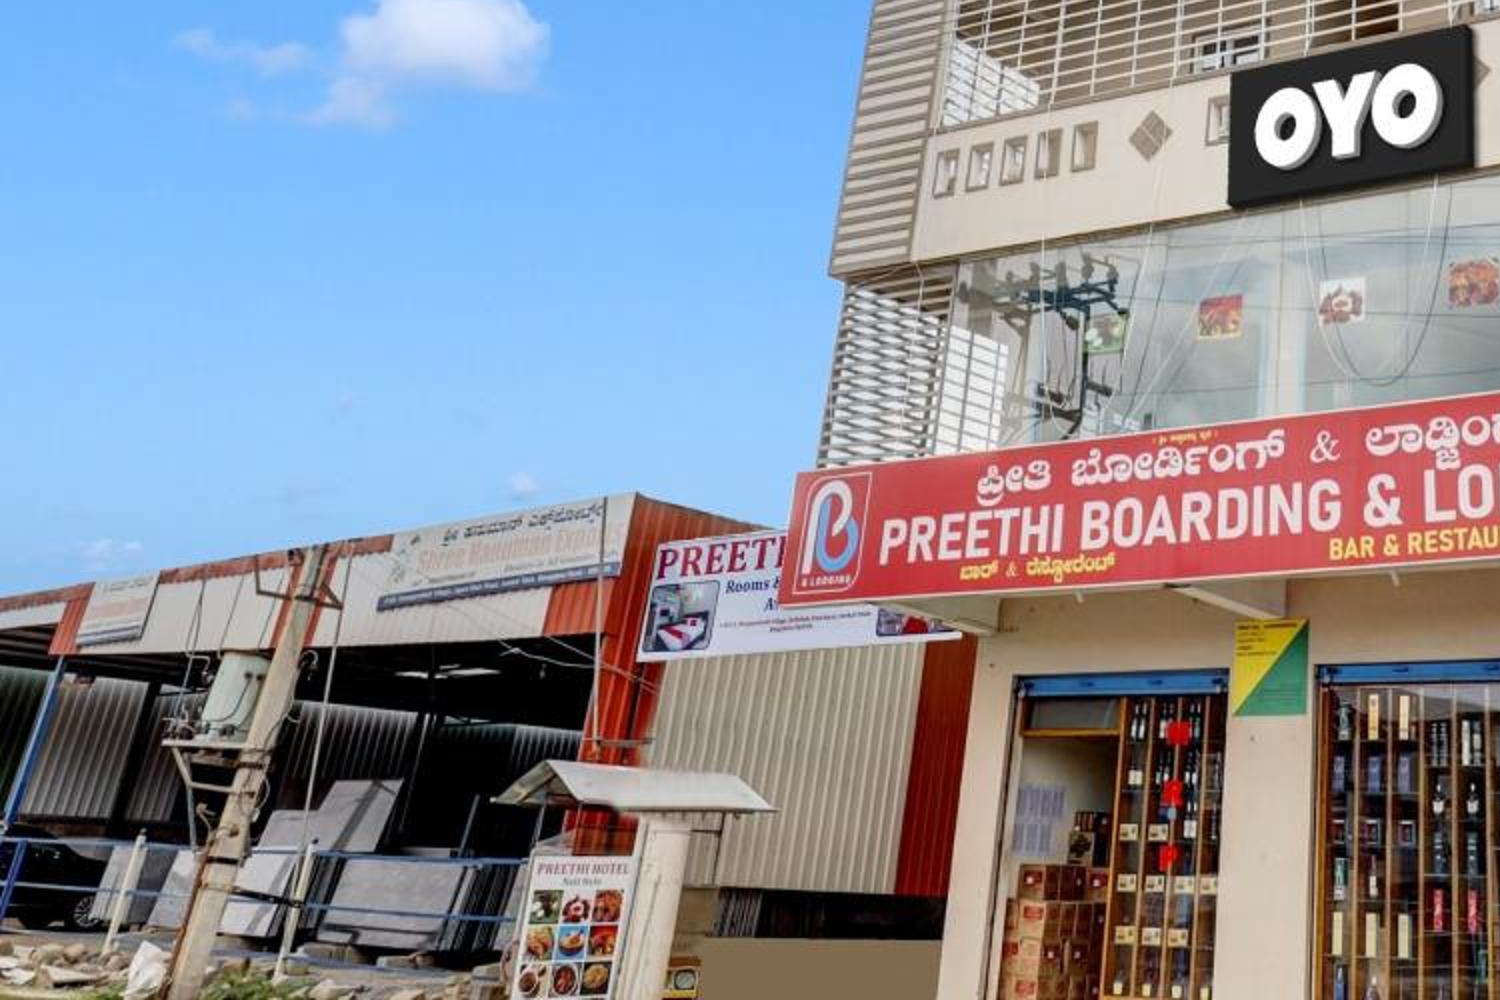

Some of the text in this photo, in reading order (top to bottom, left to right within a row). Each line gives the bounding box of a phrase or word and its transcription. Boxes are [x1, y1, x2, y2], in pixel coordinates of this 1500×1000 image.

[1254, 62, 1444, 171] OYO
[1309, 429, 1341, 464] &
[878, 503, 1064, 566] PREETHI
[1080, 478, 1342, 552] BOARDING
[1363, 473, 1404, 529] &
[1328, 535, 1375, 561] BAR
[1382, 532, 1400, 557] &
[1005, 559, 1019, 578] &
[725, 578, 770, 594] Rooms
[537, 862, 629, 876] PREETHI HOTEL
